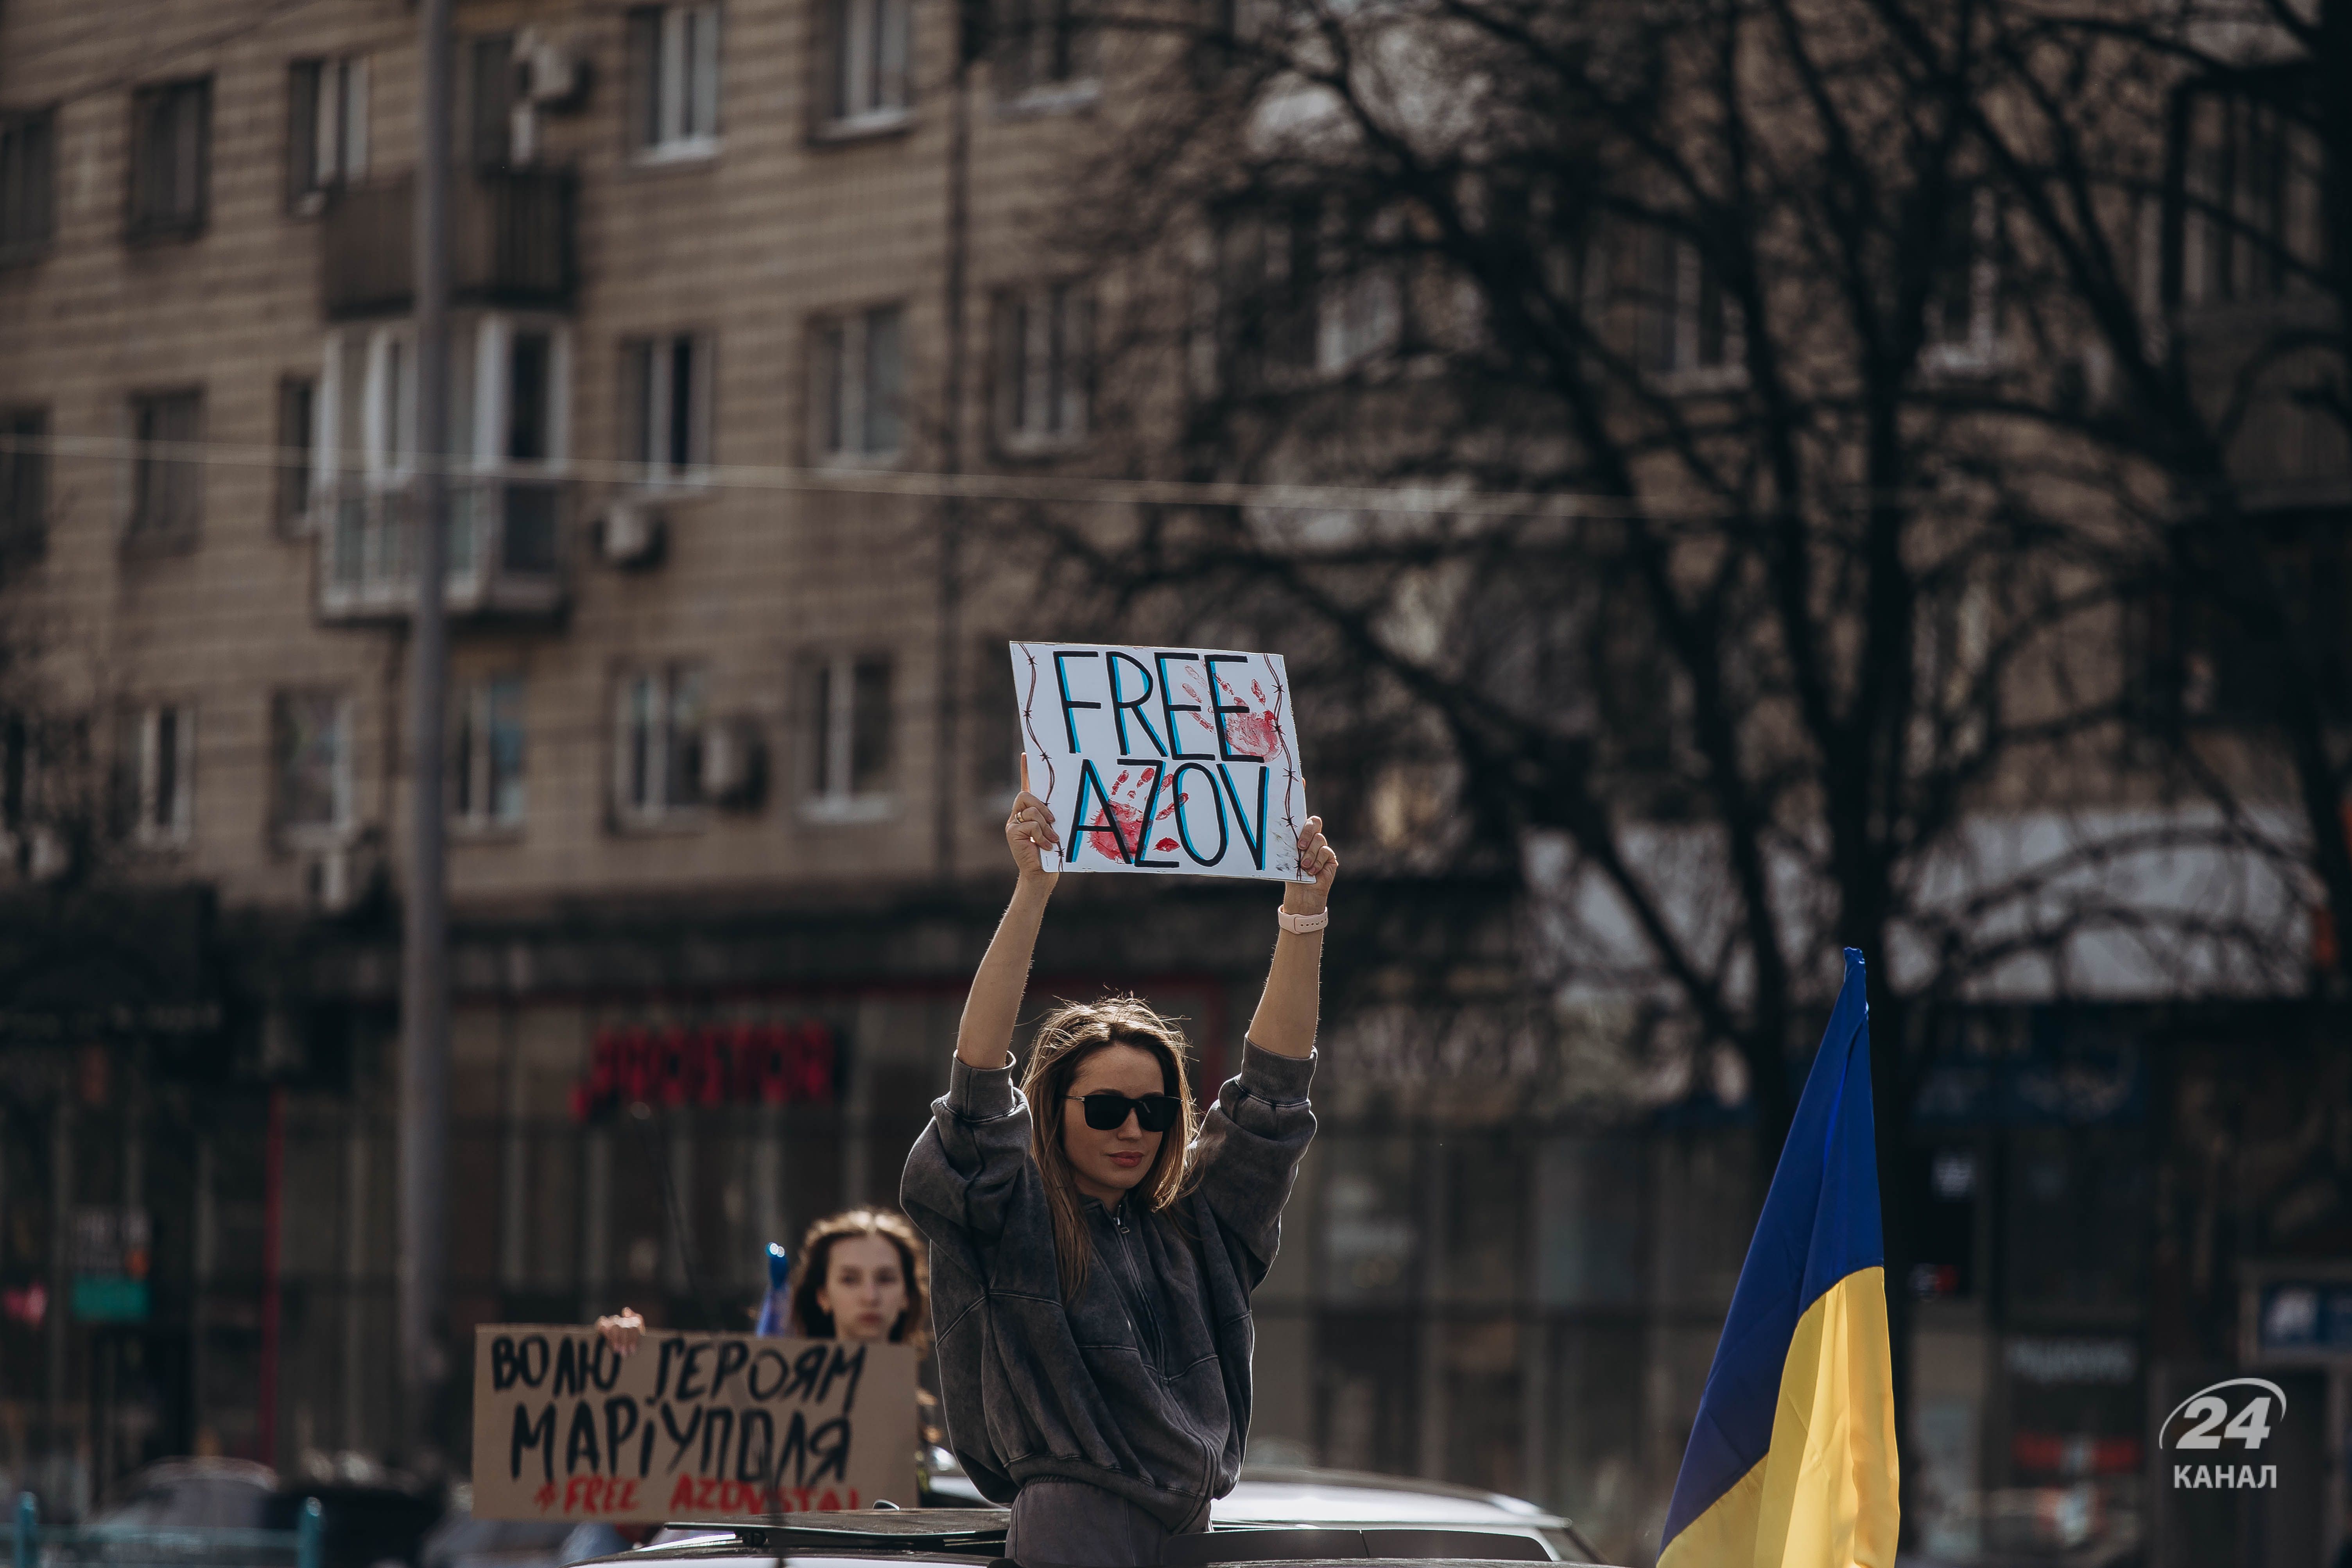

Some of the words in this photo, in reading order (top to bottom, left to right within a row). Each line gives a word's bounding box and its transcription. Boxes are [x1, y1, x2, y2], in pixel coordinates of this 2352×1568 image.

[1052, 651, 1265, 762] FREE
[1065, 758, 1270, 871] AZOV
[491, 1334, 622, 1398] ВОЛЮ
[654, 1336, 867, 1414] ГЕРОЯМ
